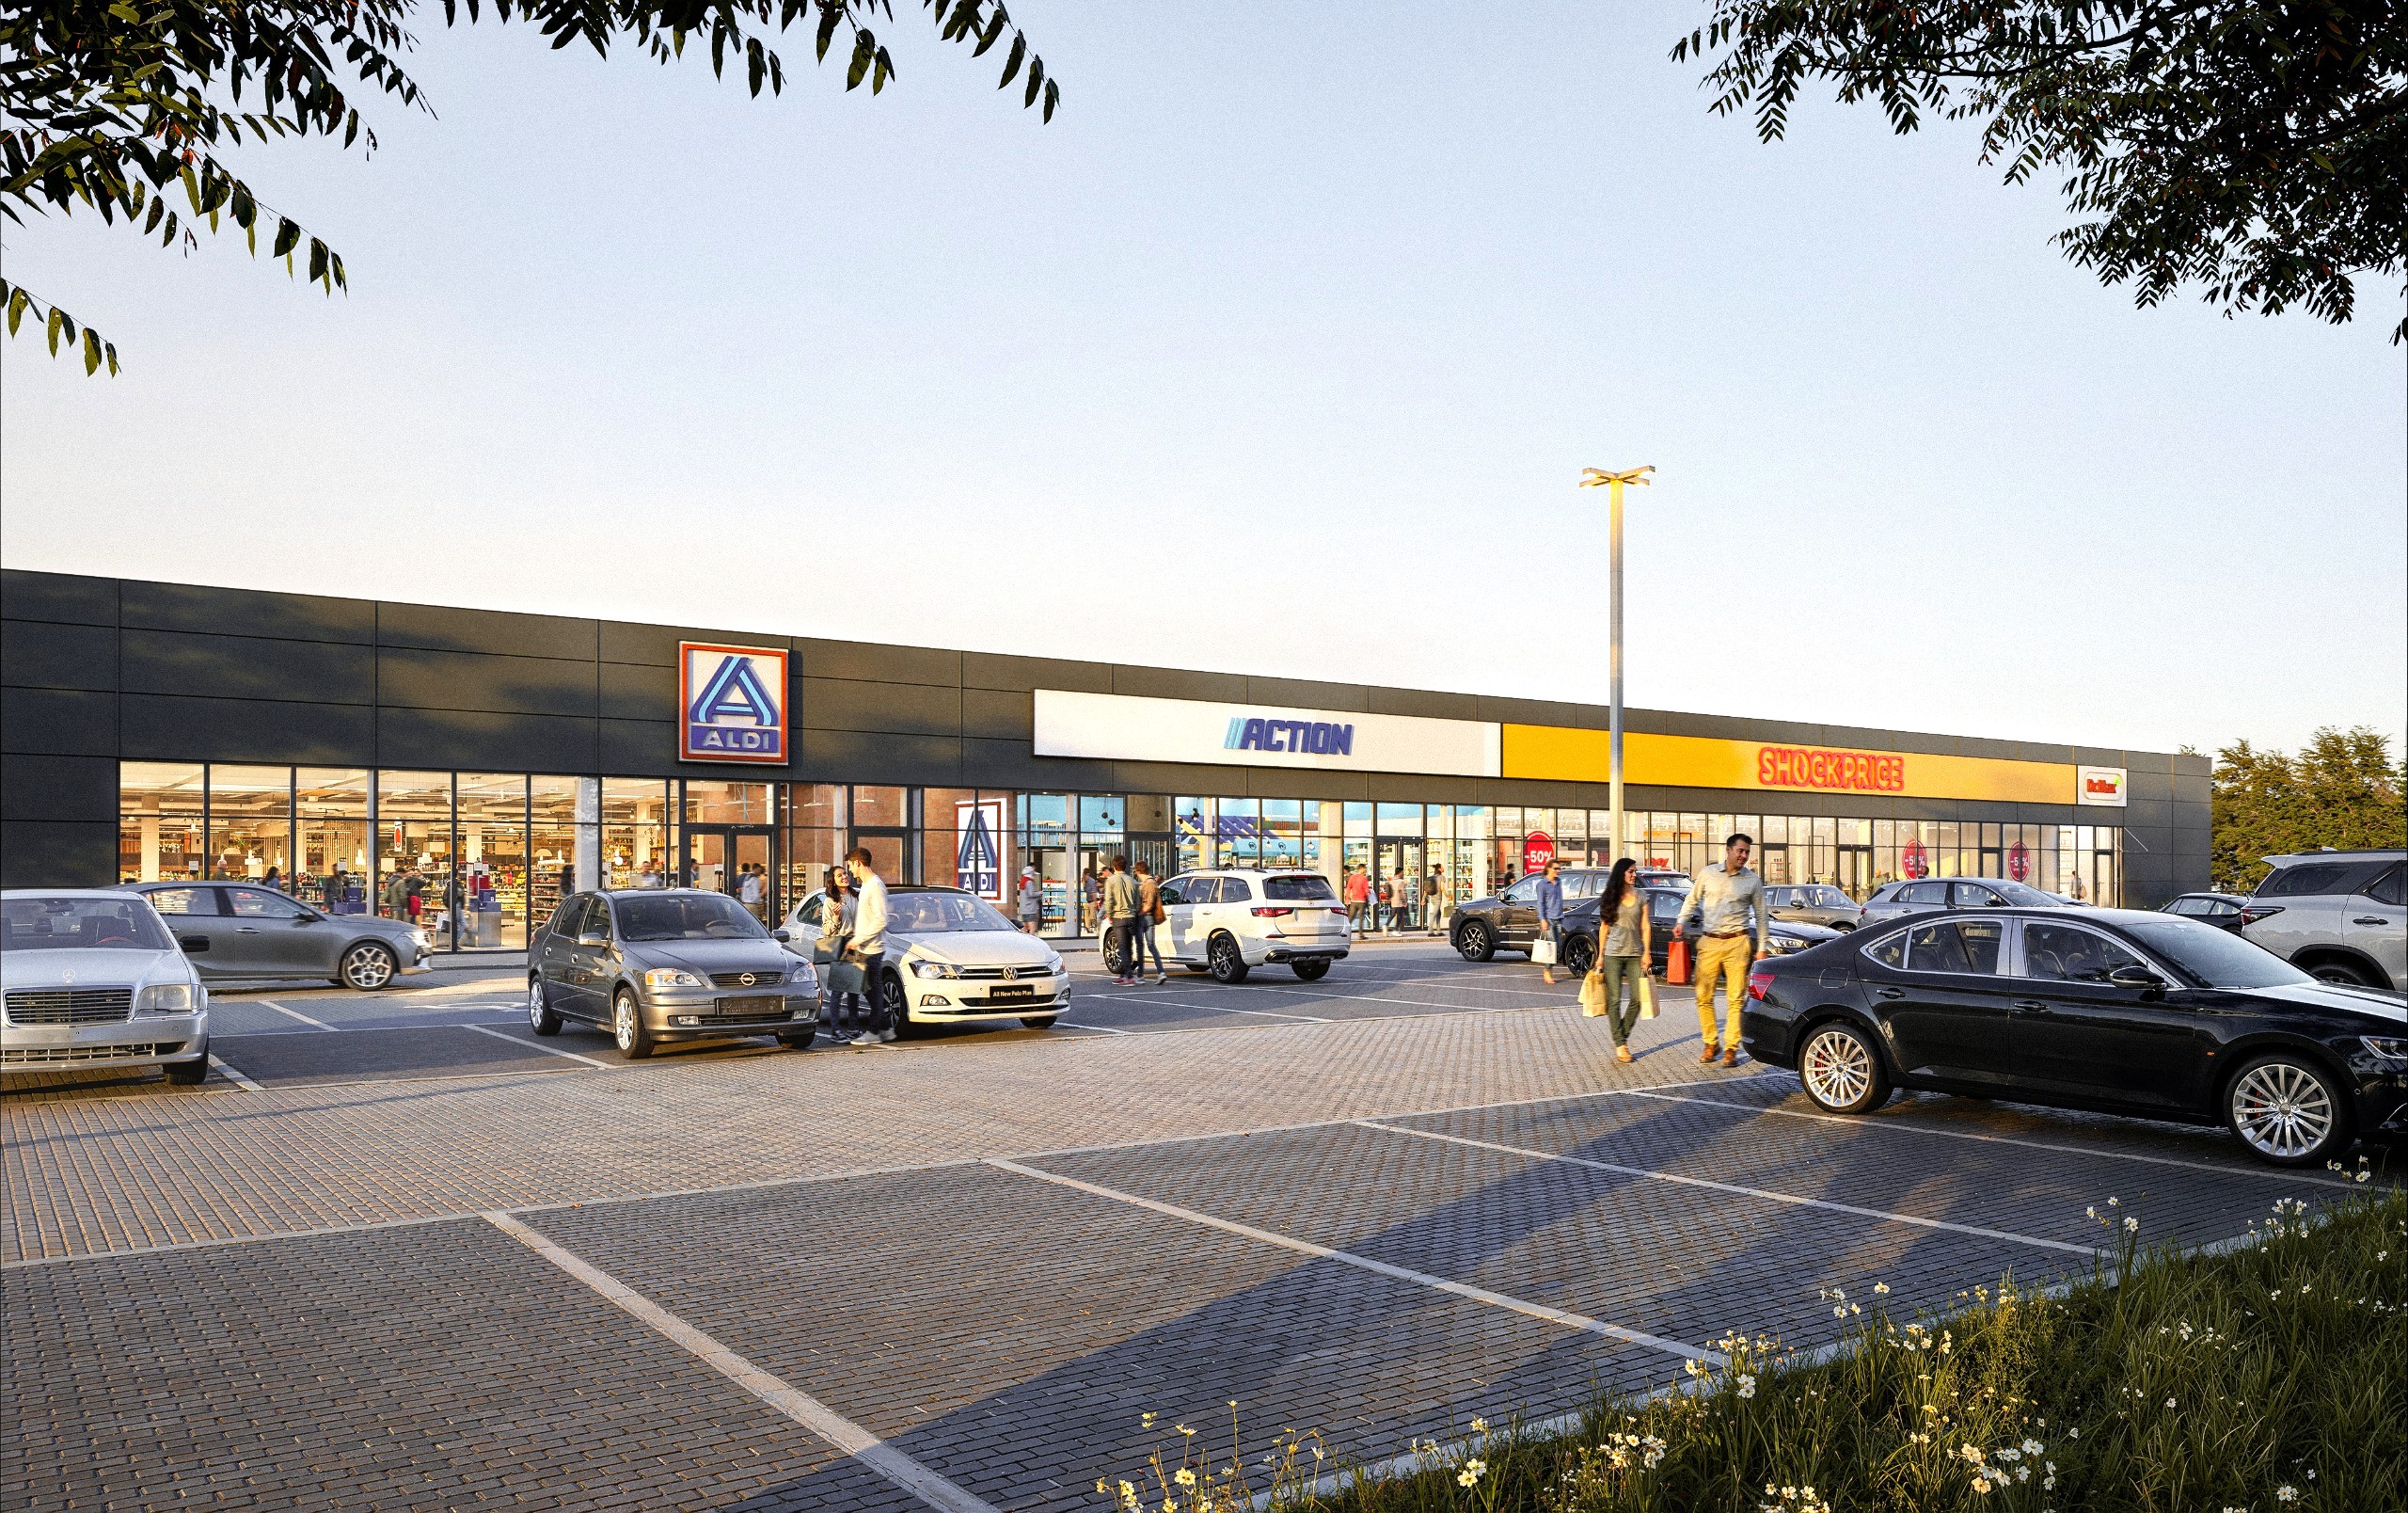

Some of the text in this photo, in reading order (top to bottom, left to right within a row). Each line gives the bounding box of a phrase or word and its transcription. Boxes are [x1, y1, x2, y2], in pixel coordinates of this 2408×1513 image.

[702, 729, 770, 750] ALDI
[1240, 718, 1354, 756] ACTION
[1758, 747, 1905, 791] SHOCKPRICE
[1524, 850, 1554, 864] -50%
[1905, 855, 1925, 867] -5%
[963, 873, 993, 891] ADI
